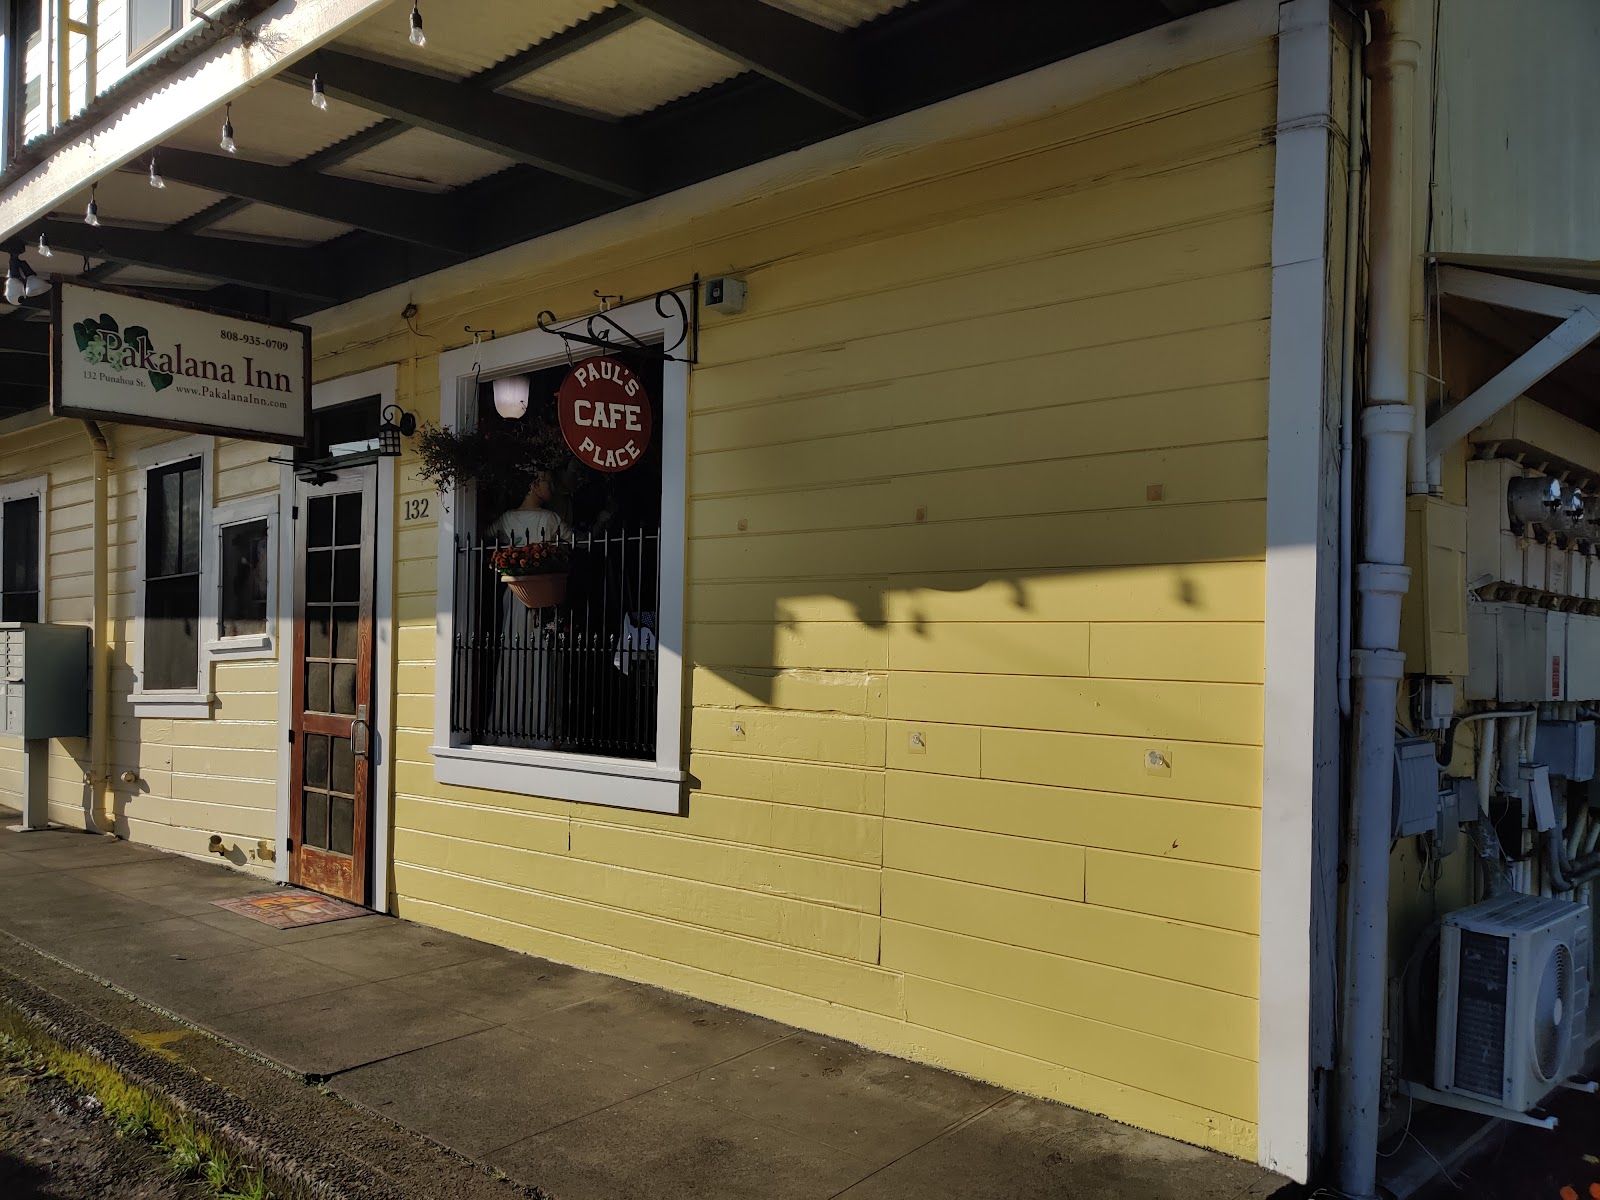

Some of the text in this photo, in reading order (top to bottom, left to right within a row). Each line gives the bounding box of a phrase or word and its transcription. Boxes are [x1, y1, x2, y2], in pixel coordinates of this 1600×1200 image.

[220, 329, 288, 350] 808-935-0709
[97, 330, 293, 393] Pakalana Inn
[84, 370, 97, 380] 132
[135, 378, 146, 388] St.
[574, 361, 640, 397] PAUL'S
[176, 386, 288, 409] www.PakalanaInn.com
[574, 399, 642, 431] CAFE
[578, 436, 641, 468] PLACE
[404, 498, 429, 520] 132
